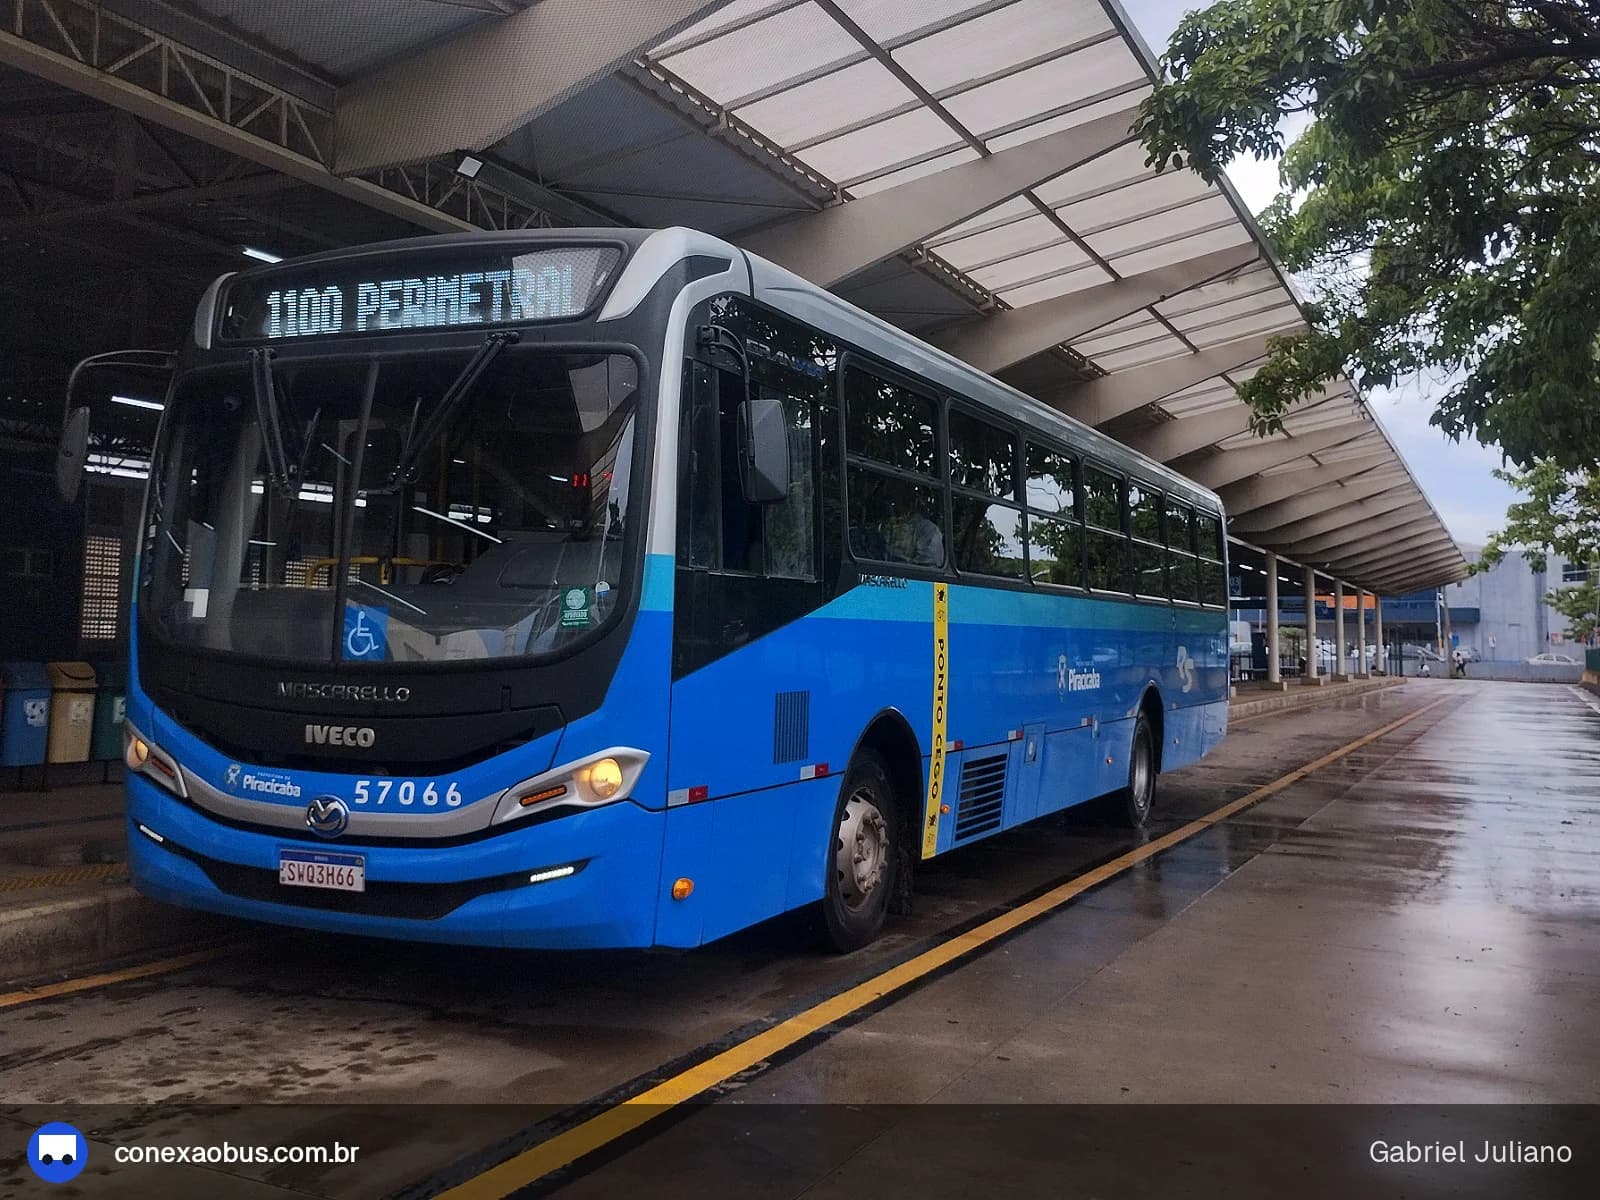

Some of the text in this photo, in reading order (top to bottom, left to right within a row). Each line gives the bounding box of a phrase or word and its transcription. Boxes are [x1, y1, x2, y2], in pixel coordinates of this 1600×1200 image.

[266, 264, 573, 339] 1100 PERIMETRAL
[278, 682, 411, 702] MASCARELLO
[1068, 667, 1100, 692] Piracicaba
[931, 638, 946, 801] PONTO CEGO
[305, 724, 376, 748] IVECO
[242, 774, 301, 798] Piracicaba
[354, 780, 462, 806] 57066
[287, 862, 355, 887] SWQ3H66
